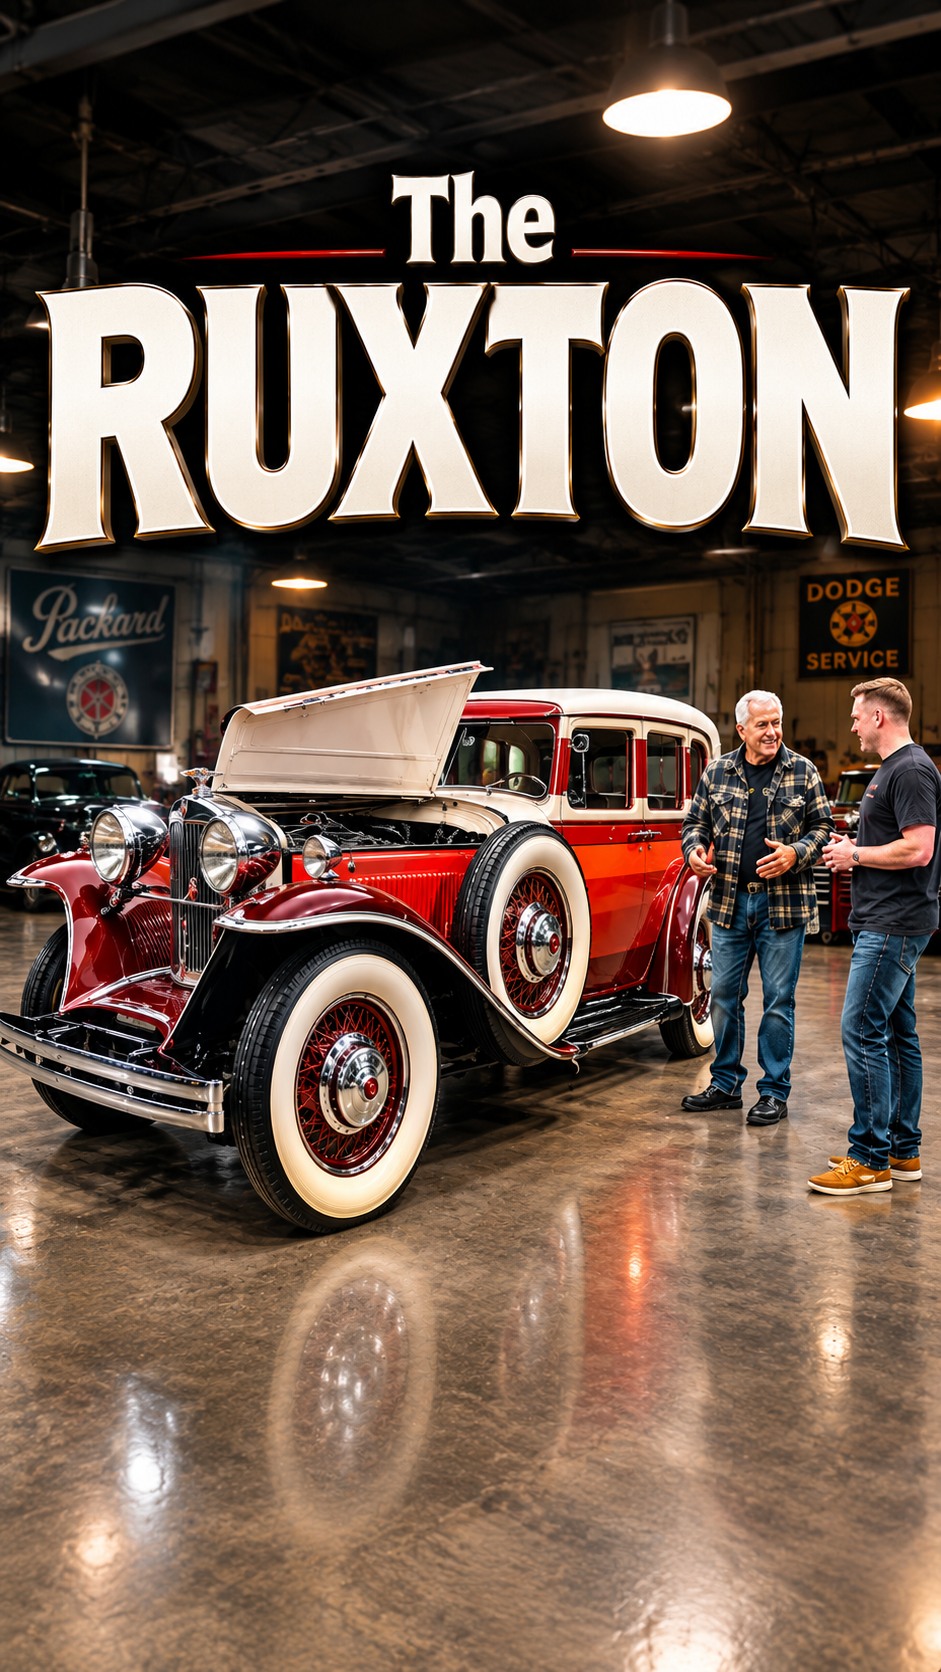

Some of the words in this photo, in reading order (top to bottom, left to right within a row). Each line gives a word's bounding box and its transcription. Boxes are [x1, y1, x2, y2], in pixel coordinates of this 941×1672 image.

[807, 577, 900, 603] DODGE
[22, 583, 170, 654] Packard
[806, 649, 899, 670] SERVICE
